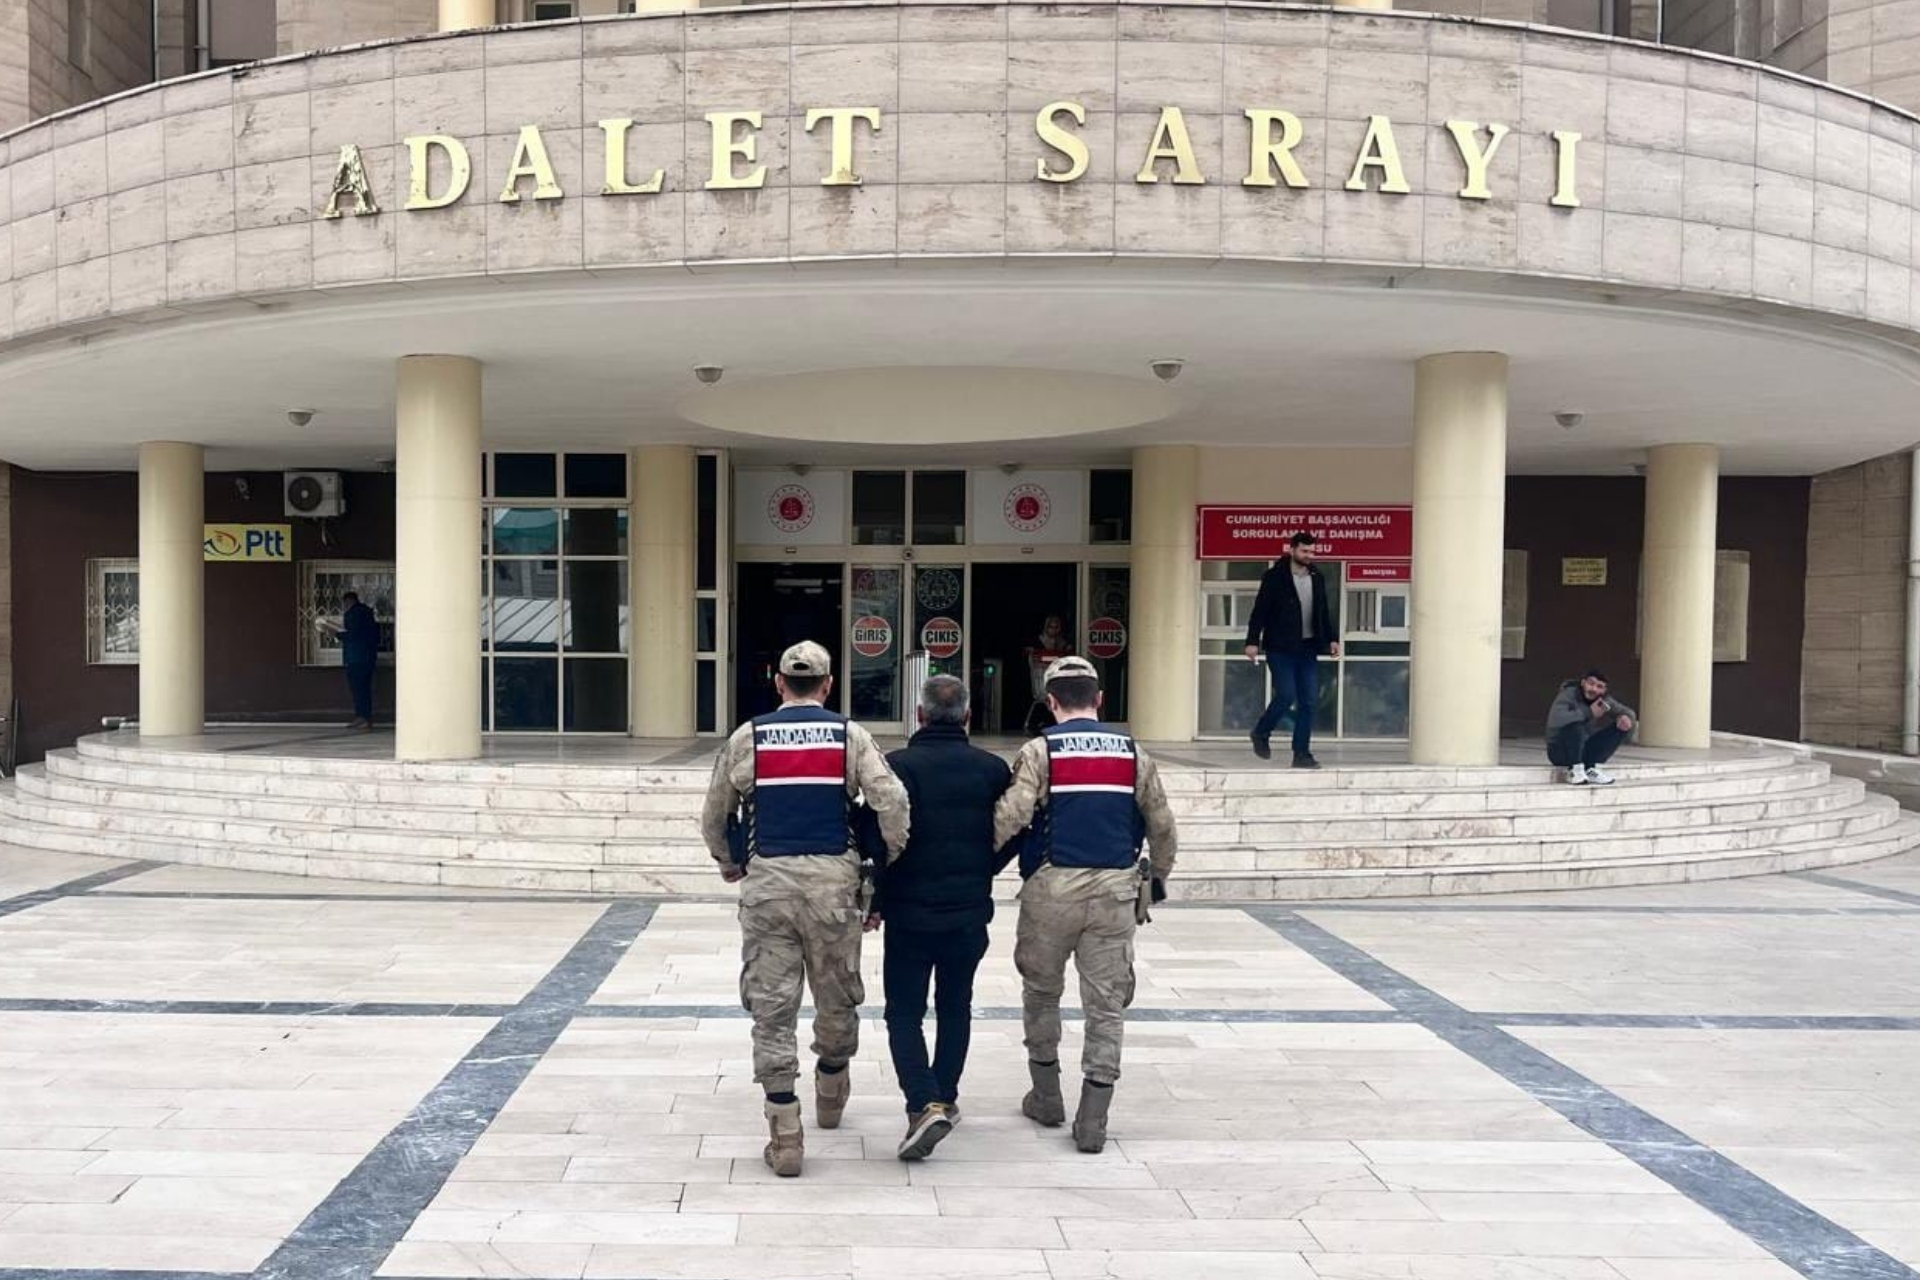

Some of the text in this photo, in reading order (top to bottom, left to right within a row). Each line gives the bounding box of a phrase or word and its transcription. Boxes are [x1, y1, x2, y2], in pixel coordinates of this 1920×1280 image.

[322, 101, 1582, 219] ADALET SARAYI
[1226, 513, 1391, 526] CUMHURİYET BAŞSAVCILIĞI
[1232, 529, 1384, 540] SORGULAM VE DANIŞMA
[246, 530, 285, 556] Ptt
[762, 728, 835, 744] JANDARMA
[1060, 736, 1129, 752] JANDARMA
